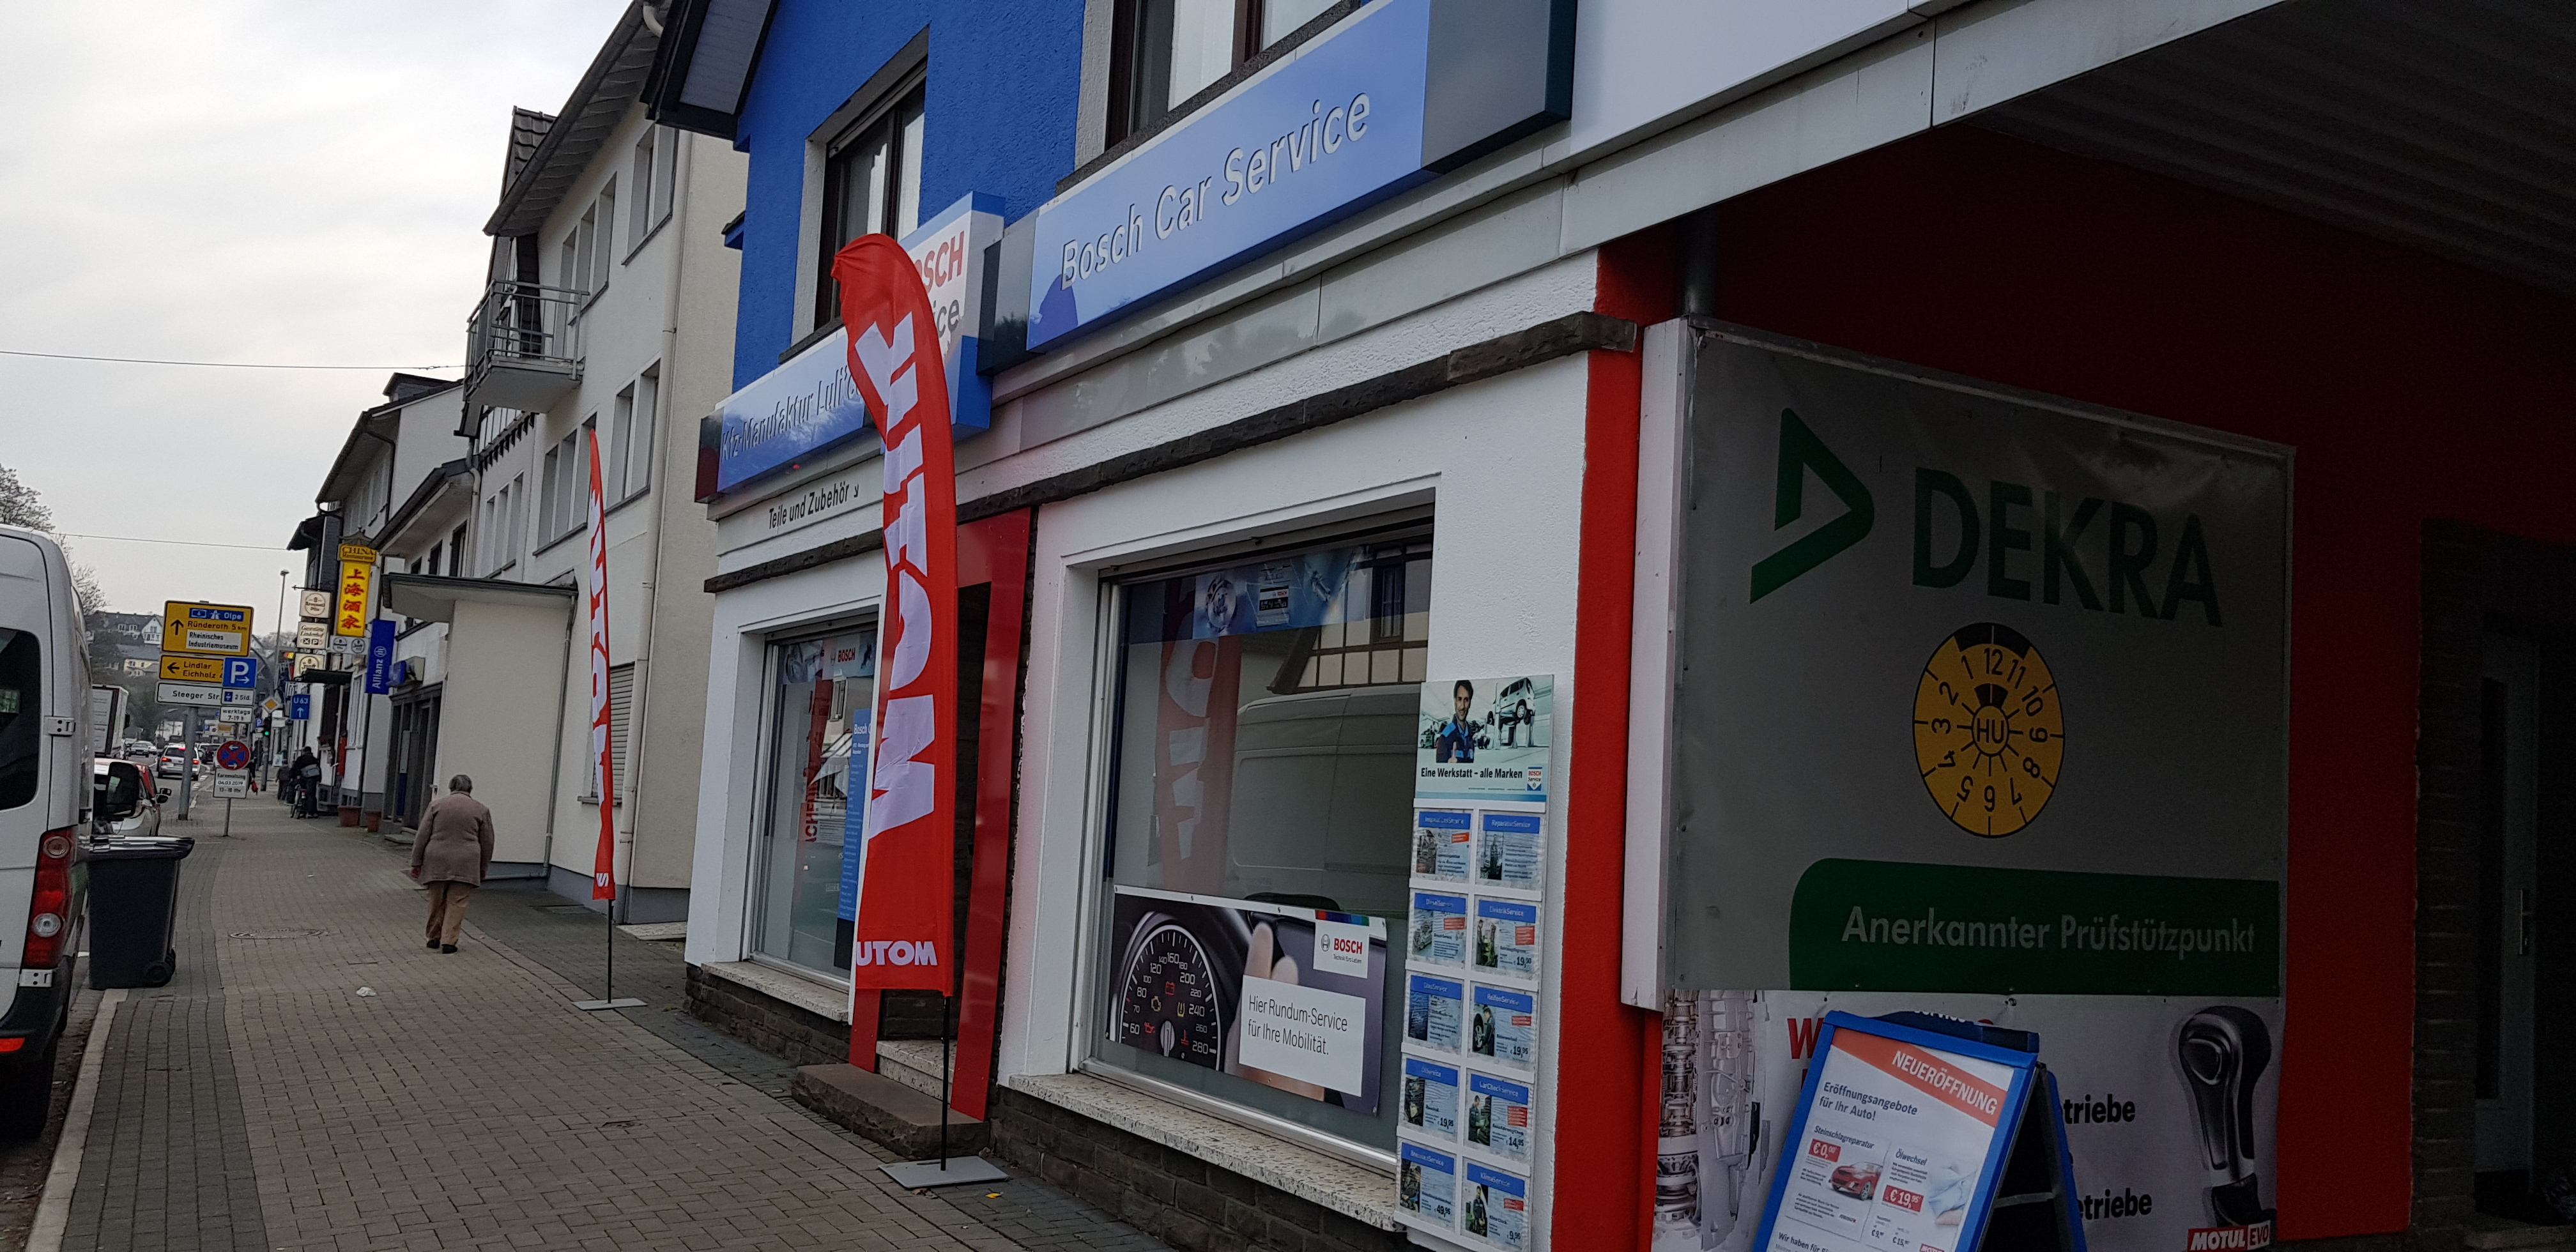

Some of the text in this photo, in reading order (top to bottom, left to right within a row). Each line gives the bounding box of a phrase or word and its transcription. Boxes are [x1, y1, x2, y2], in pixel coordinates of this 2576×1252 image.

[1061, 91, 1371, 292] Bosch Car Service
[914, 230, 965, 293] SCH
[721, 393, 813, 462] Kfz-Manufaktur
[769, 480, 849, 530] Teile und Zubehör
[342, 547, 377, 555] CHINA
[1913, 467, 2223, 629] DEKRA
[187, 620, 228, 629] Ründeroth
[224, 612, 241, 621] Olpe
[189, 632, 224, 640] Rheinisches
[188, 641, 238, 650] Industriemuseum
[838, 648, 855, 662] BOSCH
[1984, 648, 2003, 676] 12
[183, 661, 211, 669] Lindlar
[231, 661, 249, 684] P
[1961, 655, 1974, 679] 1
[372, 659, 383, 689] Allianz
[2007, 659, 2026, 689] 11
[172, 691, 203, 699] Steeger
[1939, 682, 1959, 705] 2
[2022, 685, 2043, 717] 10
[854, 723, 868, 735] Bosch
[1931, 718, 1951, 735] 3
[1977, 719, 2004, 744] HU
[2029, 727, 2048, 743] 9
[1937, 751, 1956, 767] 4
[2023, 757, 2041, 778] 8
[1421, 768, 1436, 777] Eine
[1438, 768, 1473, 778] Werkstatt
[1480, 768, 1493, 778] alle
[1494, 768, 1522, 779] Marken
[1956, 775, 1974, 802] 5
[2010, 777, 2023, 805] 7
[1841, 906, 2255, 960] Anerkannter Prüfstützpunkt
[1333, 938, 1363, 954] BOSCH
[1158, 956, 1167, 964] 140
[1167, 952, 1179, 963] 160
[1179, 961, 1188, 970] 180
[1150, 963, 1162, 974] 120
[1143, 975, 1151, 983] 100
[1180, 972, 1195, 984] 200
[1137, 987, 1147, 998] 80
[1190, 988, 1201, 998] 220
[1133, 1005, 1140, 1013] 70
[1189, 1004, 1205, 1016] 240
[1249, 994, 1347, 1032] Hier Rundum-Service
[1130, 1023, 1140, 1035] 60
[1195, 1023, 1208, 1033] 260
[1248, 1019, 1329, 1055] für Ihre Mobilität.
[1192, 1041, 1208, 1054] 280
[1892, 1050, 1998, 1115] NEUERÖFFNUNG
[1823, 1082, 1918, 1115] Eröffnungsangebote
[1819, 1097, 1876, 1121] für Ihr Auto!
[2064, 1094, 2135, 1124] triebe
[1814, 1126, 1874, 1149] Steinschlagreparatur
[1896, 1148, 1928, 1166] Ölwechsel
[1779, 1232, 1790, 1242] Wir
[1791, 1236, 1809, 1251] haben
[2190, 1224, 2269, 1251] MOTUL EVO
